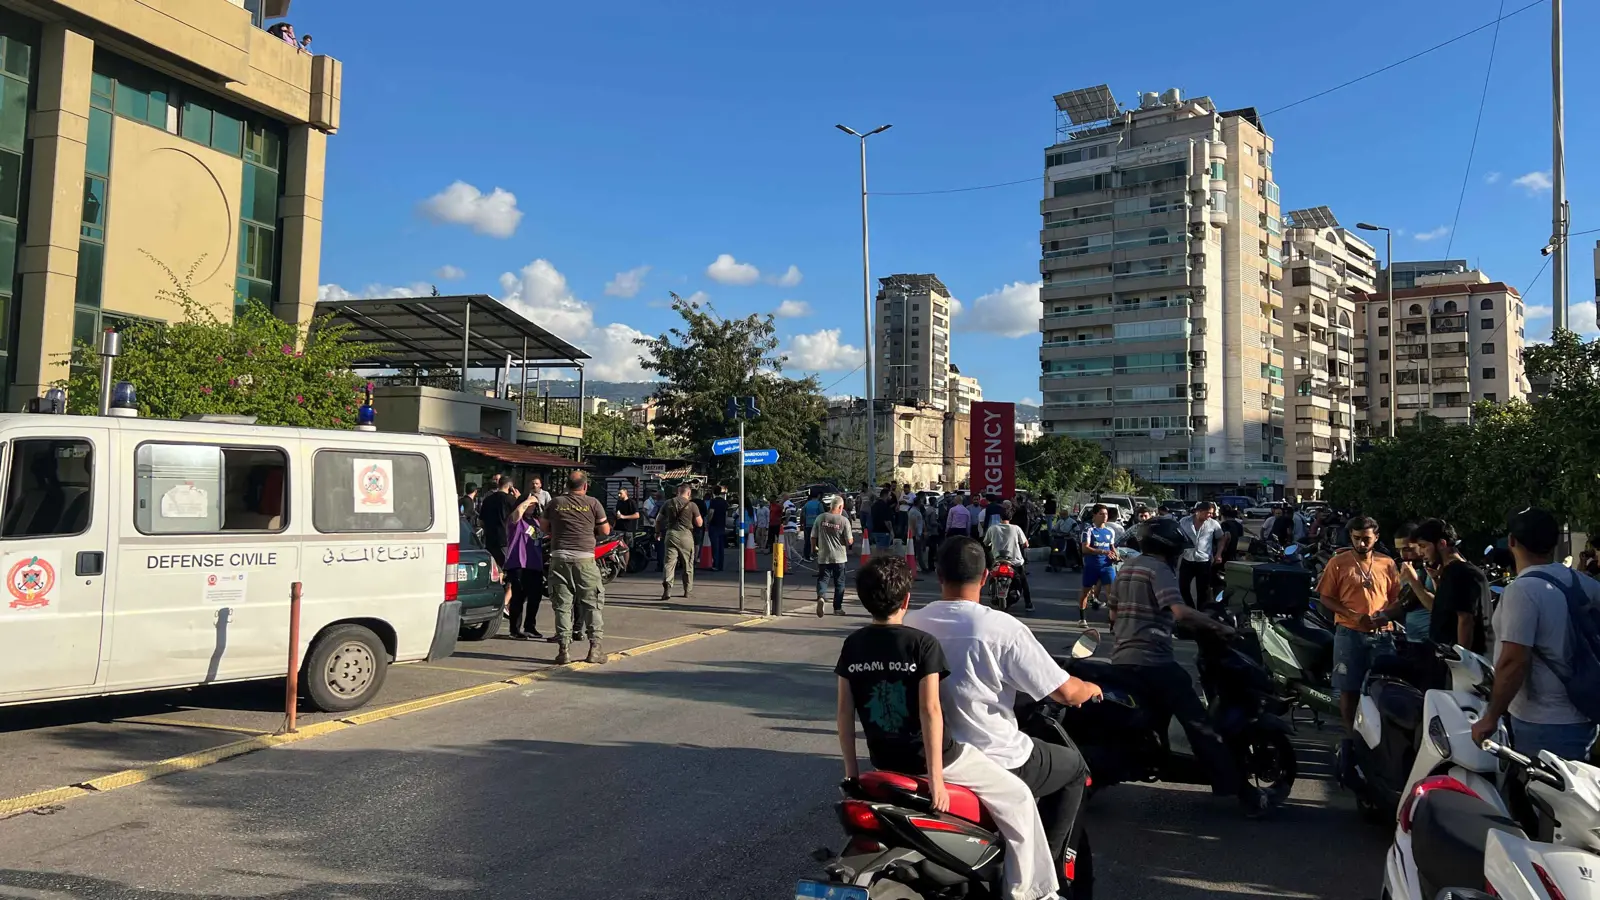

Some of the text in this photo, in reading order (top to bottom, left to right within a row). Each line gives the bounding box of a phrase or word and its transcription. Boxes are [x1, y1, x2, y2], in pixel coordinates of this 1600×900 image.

[984, 409, 1003, 496] RGENCY
[147, 552, 277, 569] DEFENSE CIVILE
[848, 661, 884, 673] OKAMI
[1309, 688, 1332, 702] KYMCO
